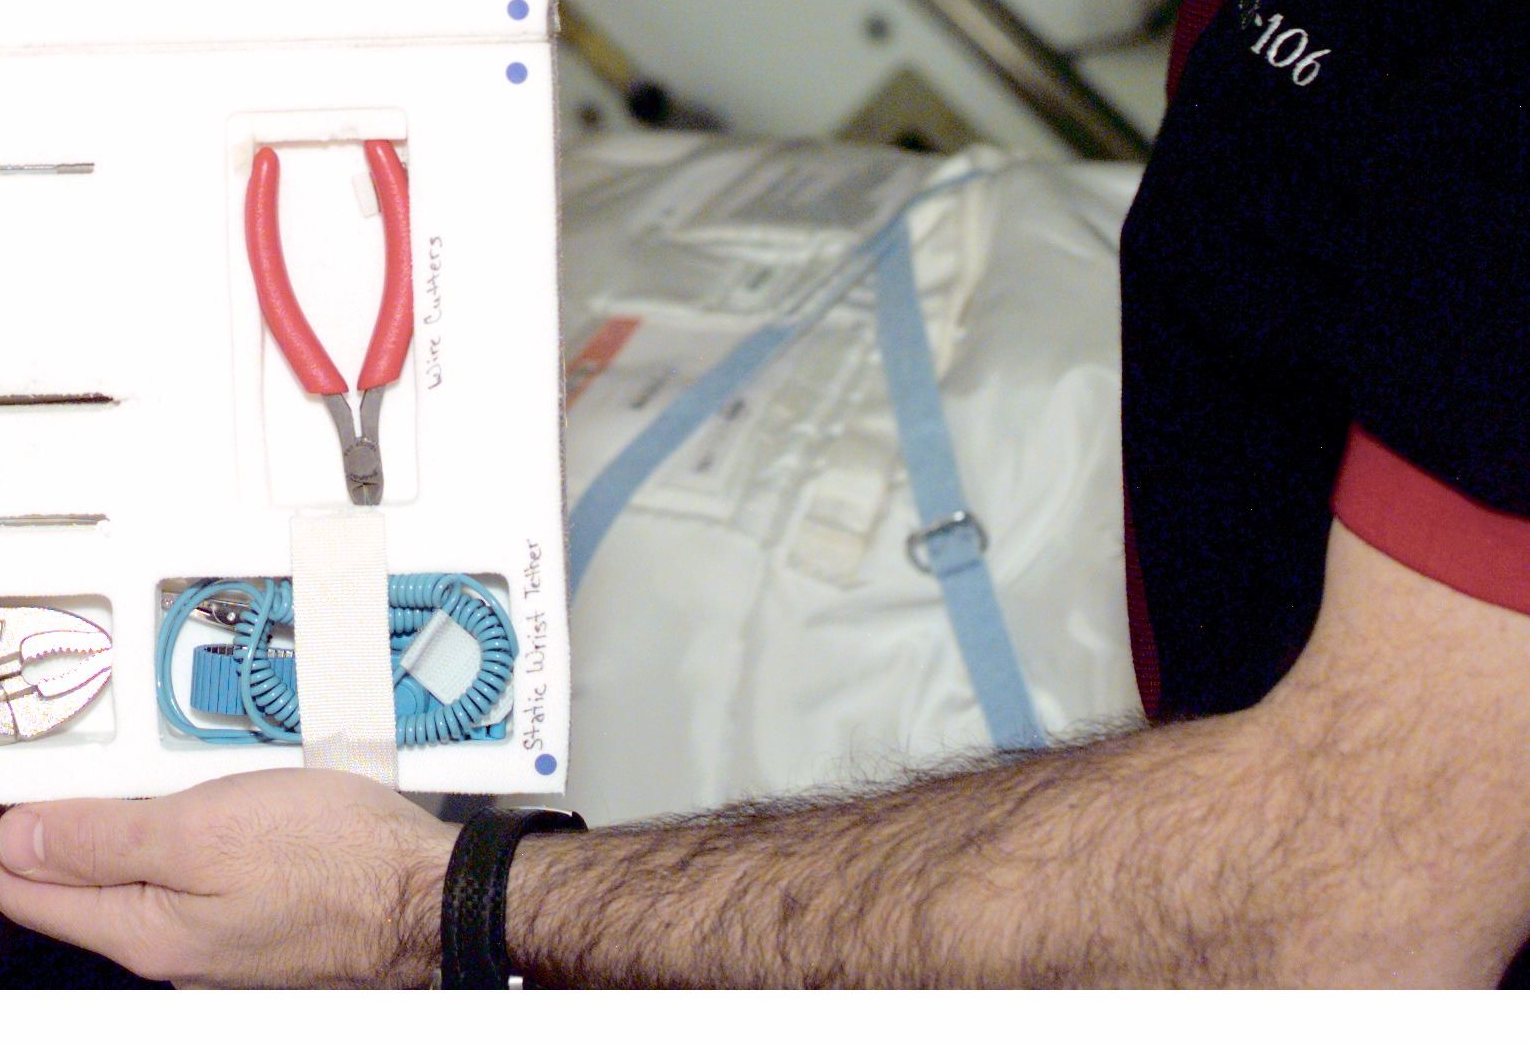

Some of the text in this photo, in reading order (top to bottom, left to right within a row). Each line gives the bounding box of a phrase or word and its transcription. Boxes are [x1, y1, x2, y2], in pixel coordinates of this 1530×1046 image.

[423, 236, 442, 390] Wire Cutters
[522, 539, 547, 751] Static Wrist Tether
